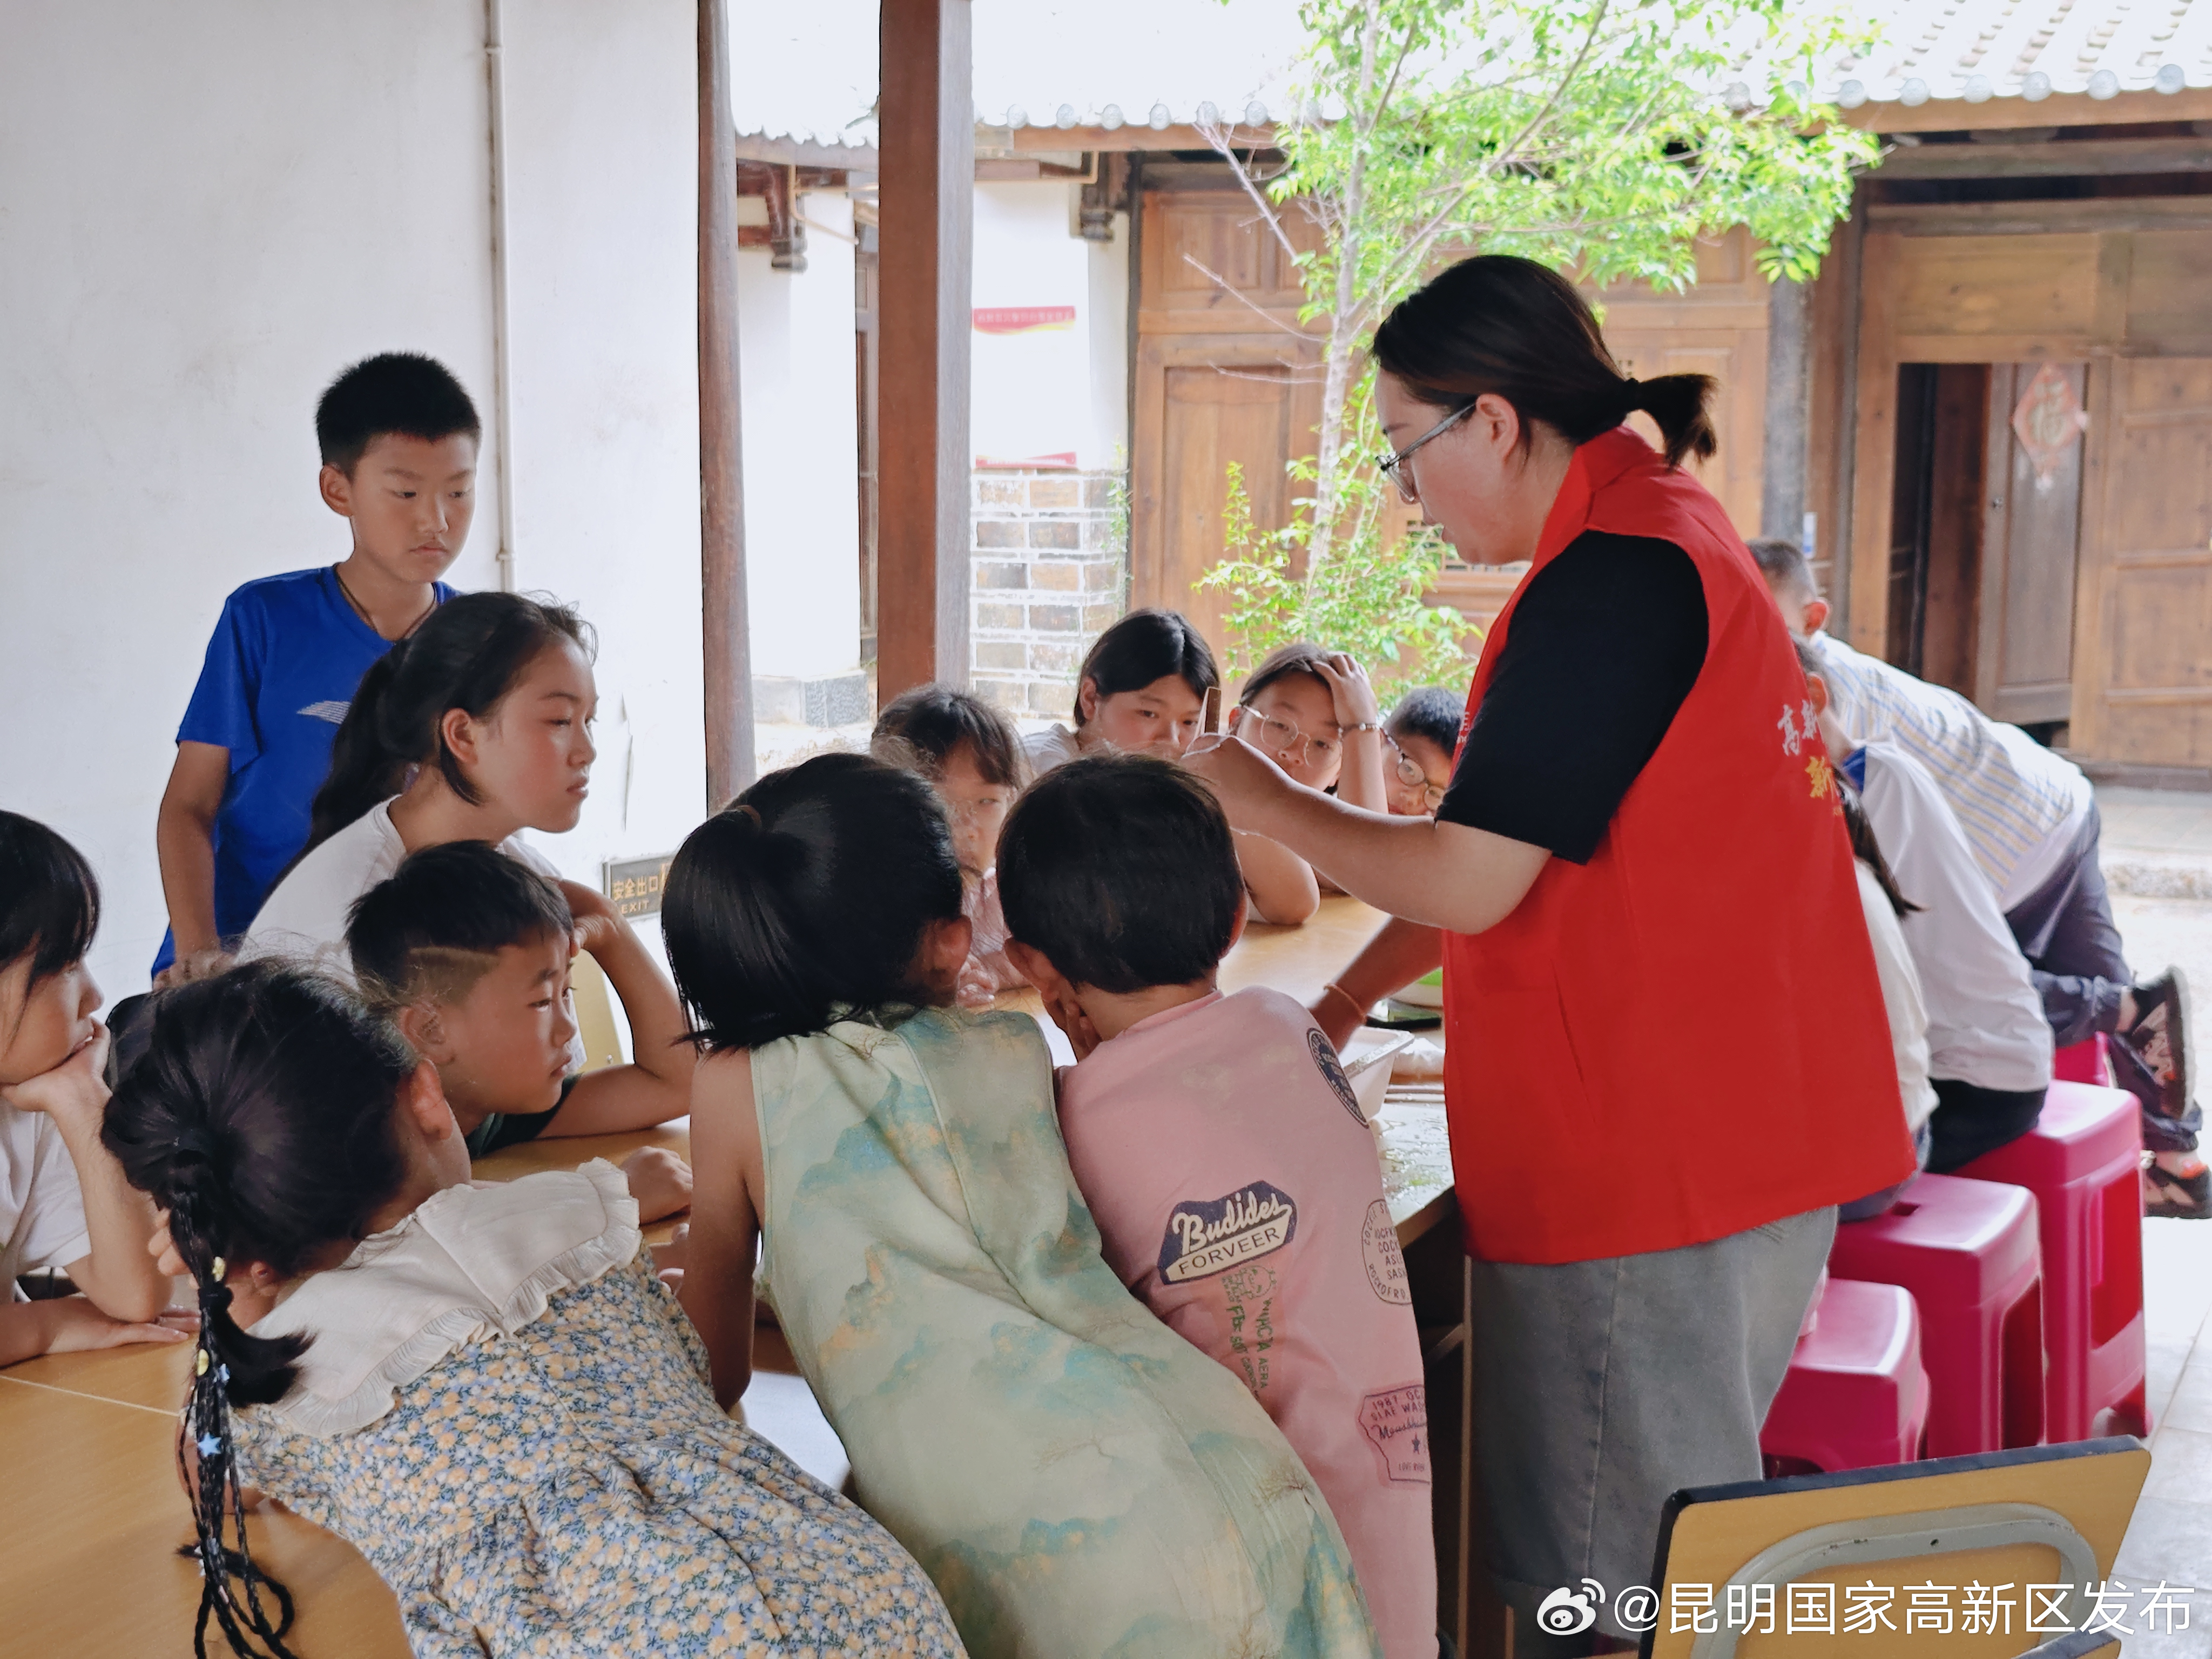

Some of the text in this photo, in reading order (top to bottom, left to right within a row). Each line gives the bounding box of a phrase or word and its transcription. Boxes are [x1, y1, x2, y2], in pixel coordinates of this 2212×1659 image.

[613, 875, 658, 901] 安全出口
[621, 900, 650, 914] EXIT
[1179, 1228, 1280, 1274] FORVEER
